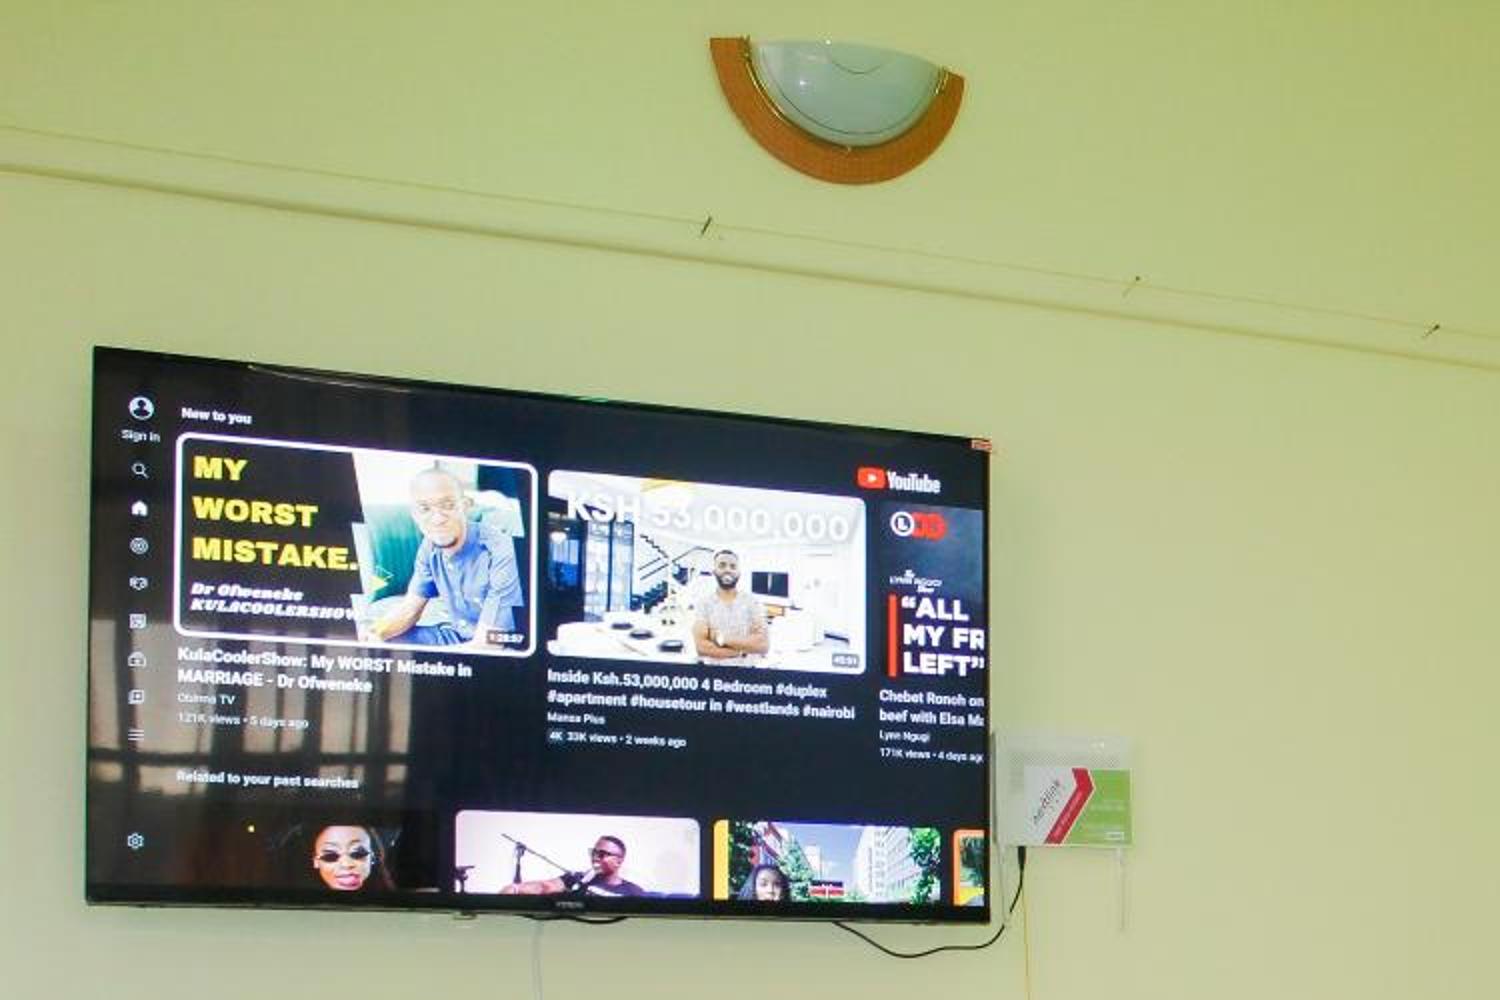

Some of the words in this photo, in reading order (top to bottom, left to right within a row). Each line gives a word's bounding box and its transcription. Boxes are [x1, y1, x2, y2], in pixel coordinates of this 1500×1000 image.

[181, 407, 210, 420] New
[212, 411, 226, 422] to
[228, 413, 252, 425] you
[120, 429, 147, 442] Sign
[193, 455, 248, 481] MY
[887, 471, 941, 494] YouTube
[192, 496, 319, 527] WORST
[567, 494, 640, 523] KSH
[192, 537, 360, 571] MISTAKE.
[191, 582, 215, 596] Dr
[903, 623, 945, 648] MY
[177, 647, 307, 668] KulaCoolerShow:
[310, 654, 335, 672] My
[337, 656, 394, 673] WORST
[397, 659, 455, 676] Mistake
[457, 663, 473, 677] in
[177, 669, 263, 687] MARRIAGE
[277, 673, 294, 689] Dr
[297, 675, 373, 693] Ofweneke
[547, 668, 591, 685] Inside
[593, 671, 699, 691] Ksh.53,000,000
[701, 679, 711, 691] 4
[713, 679, 773, 696] Bedroom
[775, 683, 828, 700] #duplex
[219, 694, 236, 705] TV
[546, 690, 627, 707] #apartment
[630, 694, 707, 711] #housetour
[709, 698, 723, 712] in
[725, 700, 800, 717] #westlands
[803, 703, 856, 720] #nairobi
[879, 689, 924, 704] Chebet
[209, 715, 241, 725] views
[583, 713, 606, 725] Plus
[879, 708, 909, 722] beef
[910, 710, 937, 724] with
[939, 712, 966, 726] Elsa
[589, 733, 618, 744] views
[625, 733, 633, 745] 2
[634, 734, 666, 747] weeks
[667, 737, 688, 748] ago
[176, 769, 225, 784] Related
[227, 773, 241, 785] to
[242, 774, 272, 787] your
[273, 775, 301, 788] past
[303, 777, 360, 790] searches
